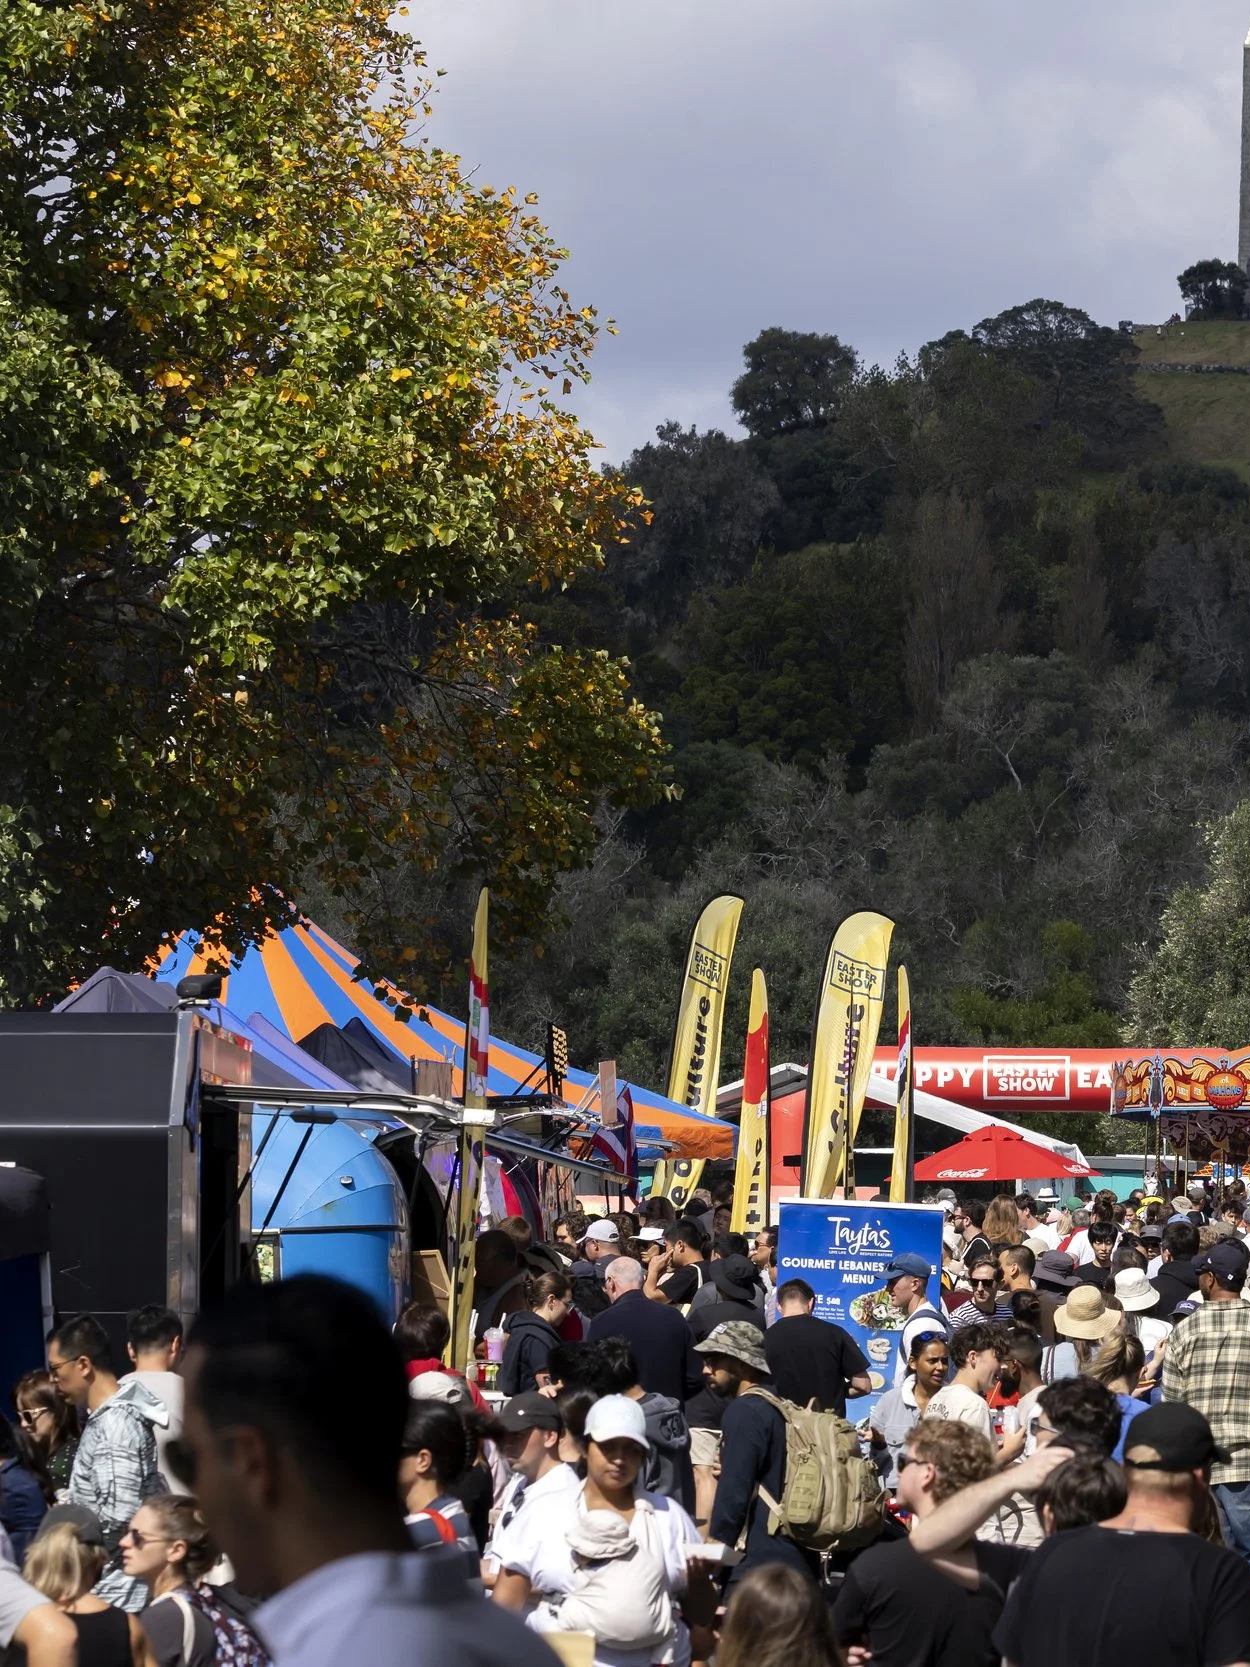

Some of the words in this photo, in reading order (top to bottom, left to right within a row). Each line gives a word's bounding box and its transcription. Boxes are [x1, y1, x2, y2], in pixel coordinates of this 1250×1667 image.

[695, 950, 722, 975] EASTER
[695, 963, 721, 983] SHOW
[837, 960, 877, 984] EASTER
[838, 972, 873, 990] SHOW
[685, 996, 711, 1108] ulture
[992, 1063, 1059, 1078] EASTER
[998, 1078, 1054, 1092] SHOW
[1208, 1085, 1242, 1096] MAHONS
[827, 1216, 891, 1255] Tayta's
[781, 1257, 836, 1270] GOURMET
[838, 1260, 885, 1272] LEBANES
[842, 1273, 875, 1285] MENU
